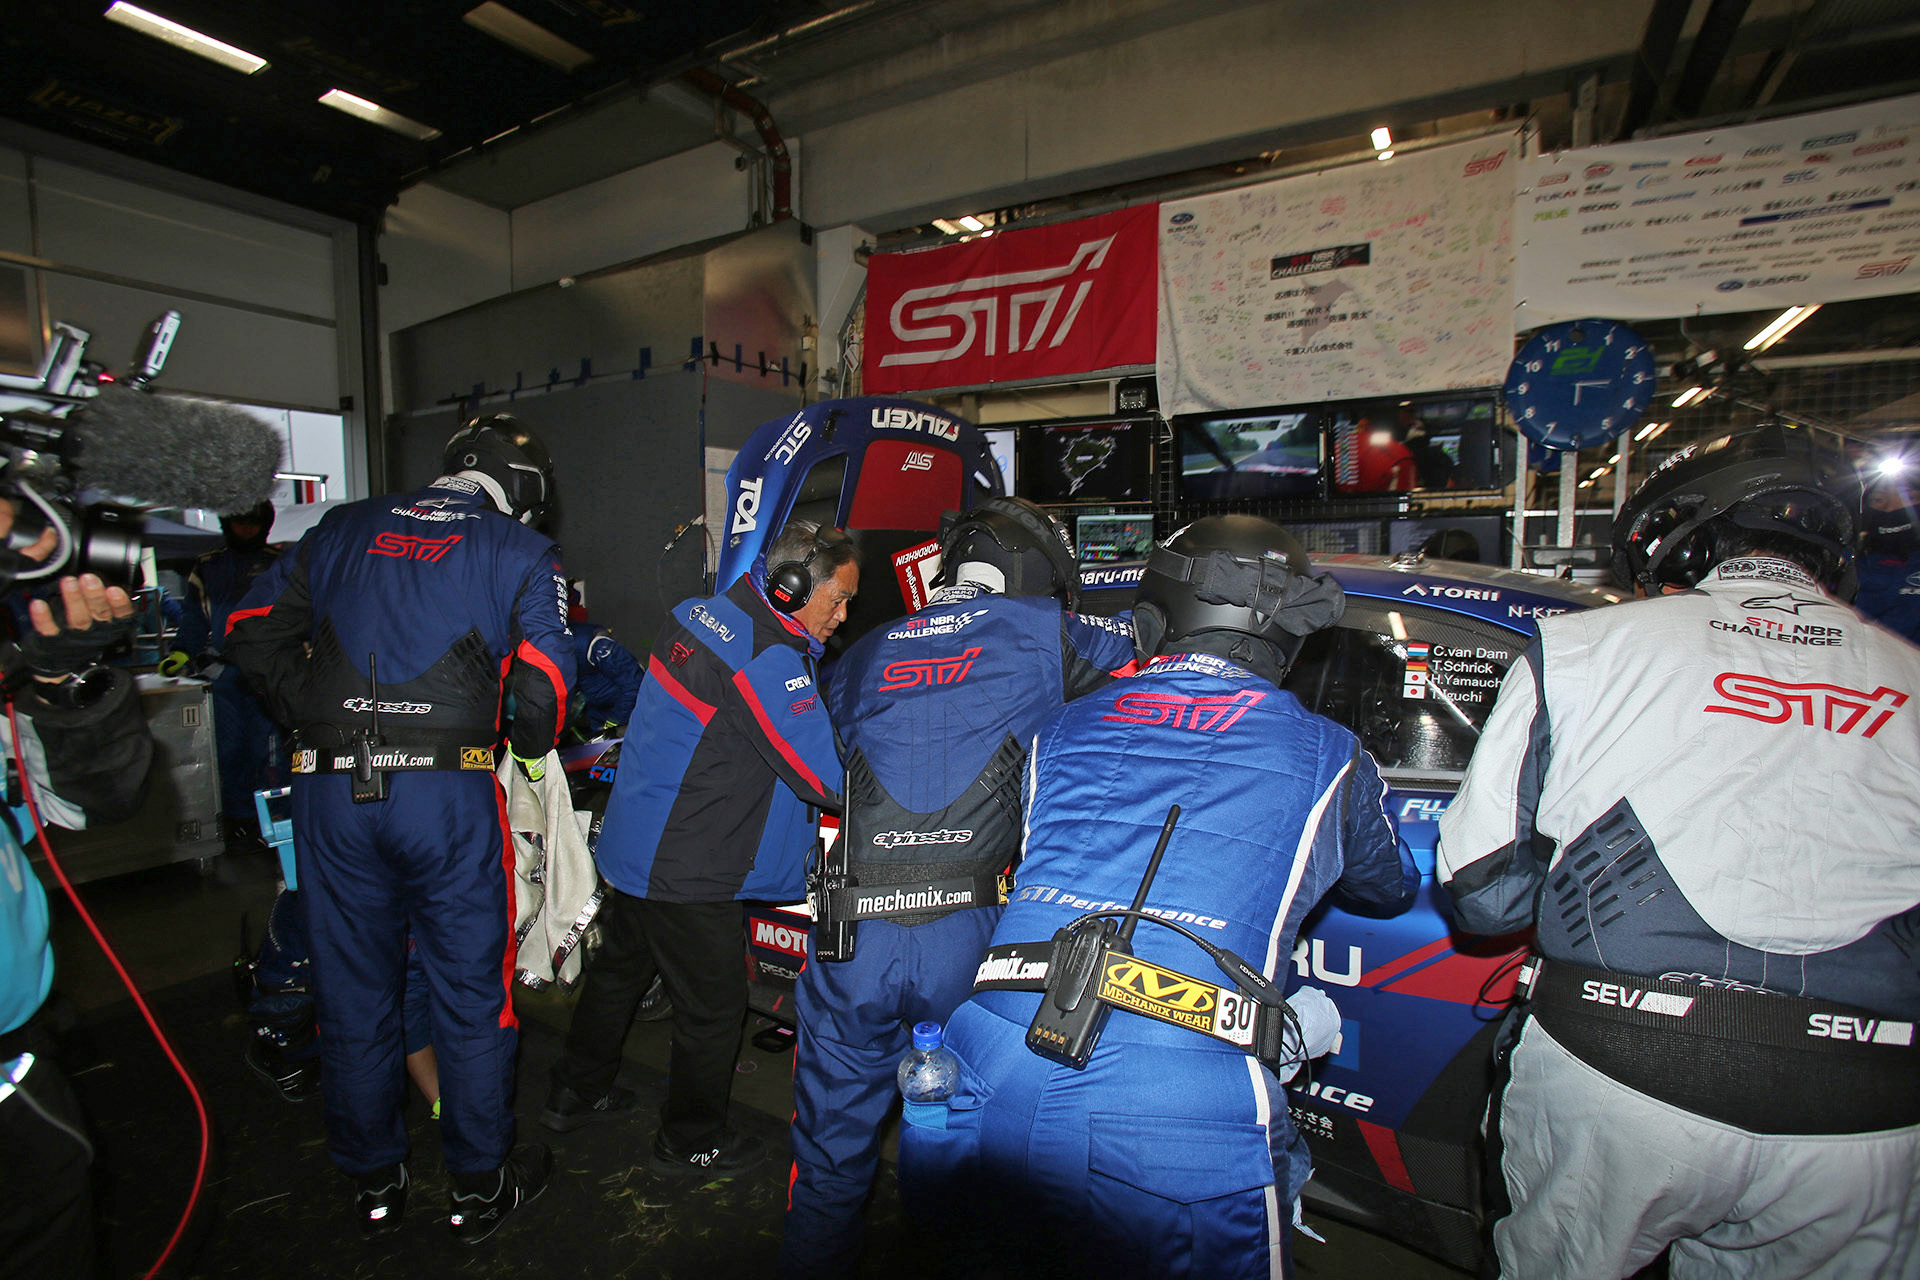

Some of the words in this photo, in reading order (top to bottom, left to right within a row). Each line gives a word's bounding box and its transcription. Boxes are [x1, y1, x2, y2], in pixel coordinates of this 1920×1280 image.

[1463, 150, 1507, 178] STI
[1312, 250, 1337, 262] NBR
[1271, 261, 1334, 278] CHALLENGE
[1855, 255, 1916, 281] STI
[1747, 272, 1811, 289] SUBARU
[879, 232, 1118, 368] STI
[1545, 339, 1562, 353] 11
[1603, 333, 1615, 346] 1
[1624, 346, 1638, 360] 2
[1524, 359, 1543, 373] 10
[1632, 371, 1645, 385] 3
[1517, 382, 1530, 395] 9
[1622, 396, 1635, 410] 4
[1524, 406, 1536, 419] 8
[871, 406, 960, 442] FALKEN
[1601, 416, 1613, 430] 5
[775, 421, 812, 465] STC
[367, 532, 464, 562] STI
[896, 541, 939, 567] NORDRHEIN
[1429, 586, 1500, 602] TORII
[1508, 605, 1566, 618] N-K
[698, 611, 736, 643] SUBARU
[906, 618, 927, 630] STI
[929, 614, 955, 627] NBR
[1745, 616, 1784, 632] STI
[1793, 624, 1844, 638] NBR
[887, 625, 955, 641] CHALLENGE
[1708, 619, 1843, 647] CHALLENGE
[1187, 653, 1227, 669] NBR
[1433, 645, 1472, 659] C.van
[1475, 647, 1508, 660] Dam
[878, 646, 983, 692] STI
[1132, 661, 1221, 679] CHALLENGE
[1432, 660, 1493, 674] T.Schrick
[784, 674, 812, 692] CREW
[343, 697, 432, 714] alpnestars
[790, 693, 818, 716] STI
[1100, 689, 1268, 732] STI
[1703, 672, 1910, 739] STI
[334, 751, 434, 770] meanix.com
[873, 828, 973, 848] alpinestars
[856, 886, 973, 915] mechanix.com
[1017, 885, 1060, 902] STI
[1238, 963, 1268, 989] KENWOOD
[1581, 980, 1642, 1009] SEV
[1102, 981, 1172, 1017] MECHANIX
[1171, 1009, 1212, 1031] WEAR
[1221, 997, 1251, 1031] 30
[1806, 1013, 1875, 1043] SEV
